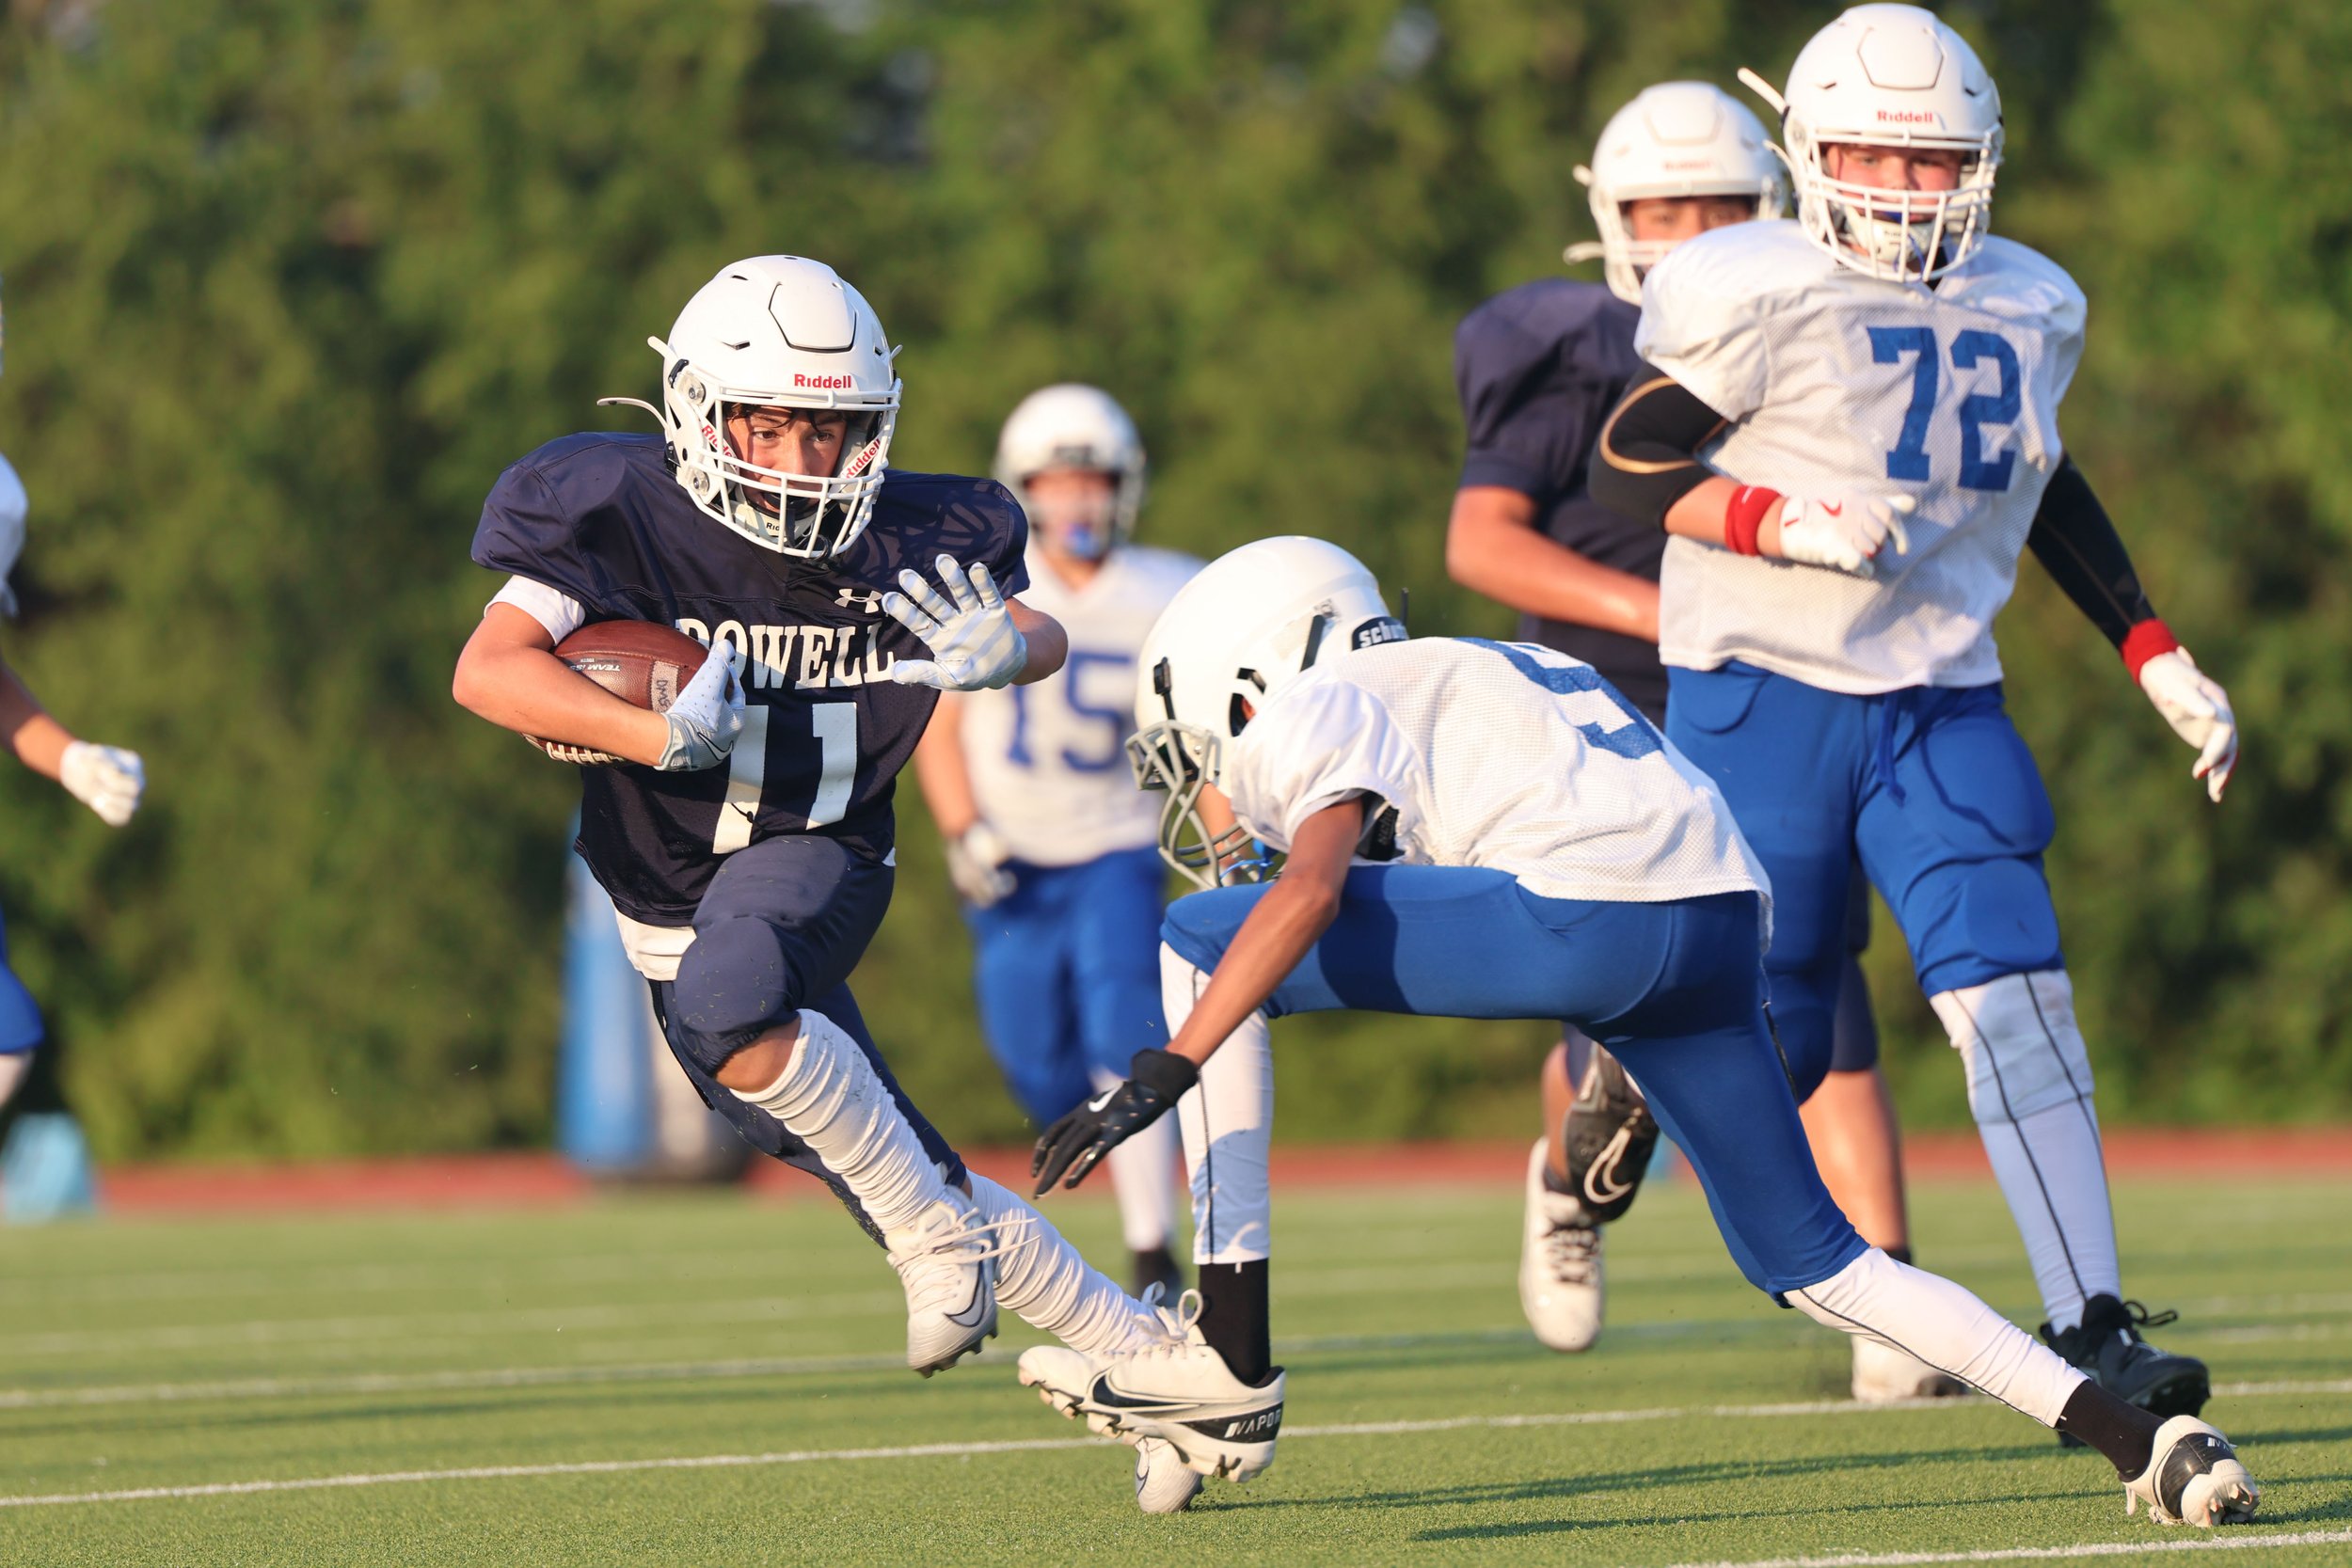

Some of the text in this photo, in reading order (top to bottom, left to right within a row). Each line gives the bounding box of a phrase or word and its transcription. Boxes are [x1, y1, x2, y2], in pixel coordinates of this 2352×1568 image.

[1877, 110, 1933, 122] Riddell
[794, 373, 851, 388] Riddell
[1867, 326, 2021, 492] 72
[1359, 621, 1409, 648] sch
[1007, 651, 1133, 773] 15
[712, 702, 857, 854] 11
